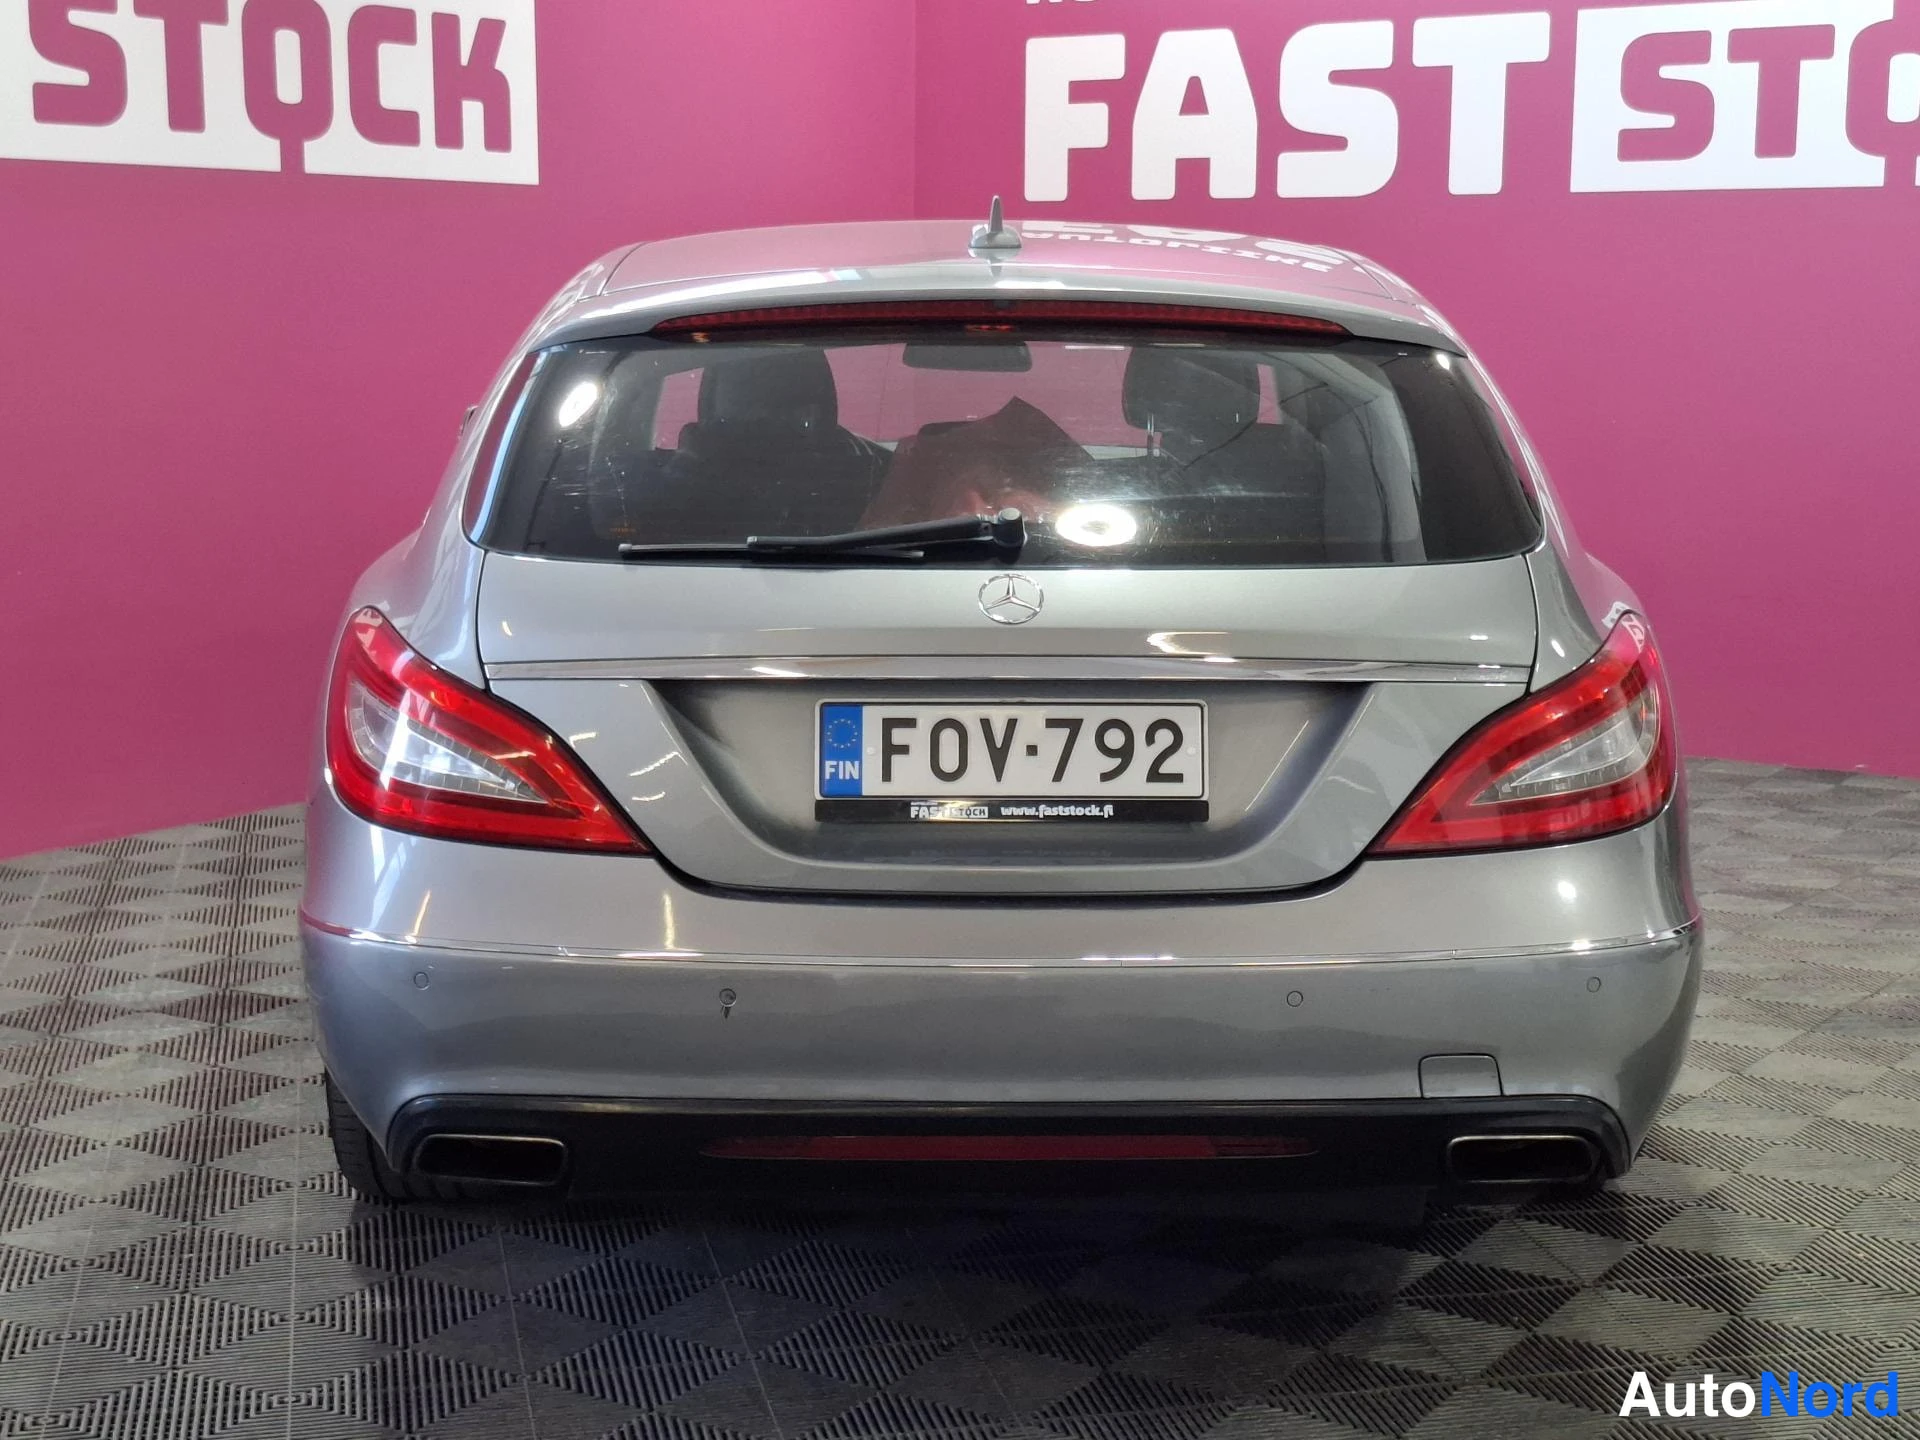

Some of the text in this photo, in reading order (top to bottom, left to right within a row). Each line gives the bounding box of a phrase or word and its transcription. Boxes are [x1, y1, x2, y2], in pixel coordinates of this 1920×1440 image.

[1024, 12, 1551, 202] FAST
[824, 761, 860, 780] FIN
[1000, 804, 1115, 819] www.faststock.fi
